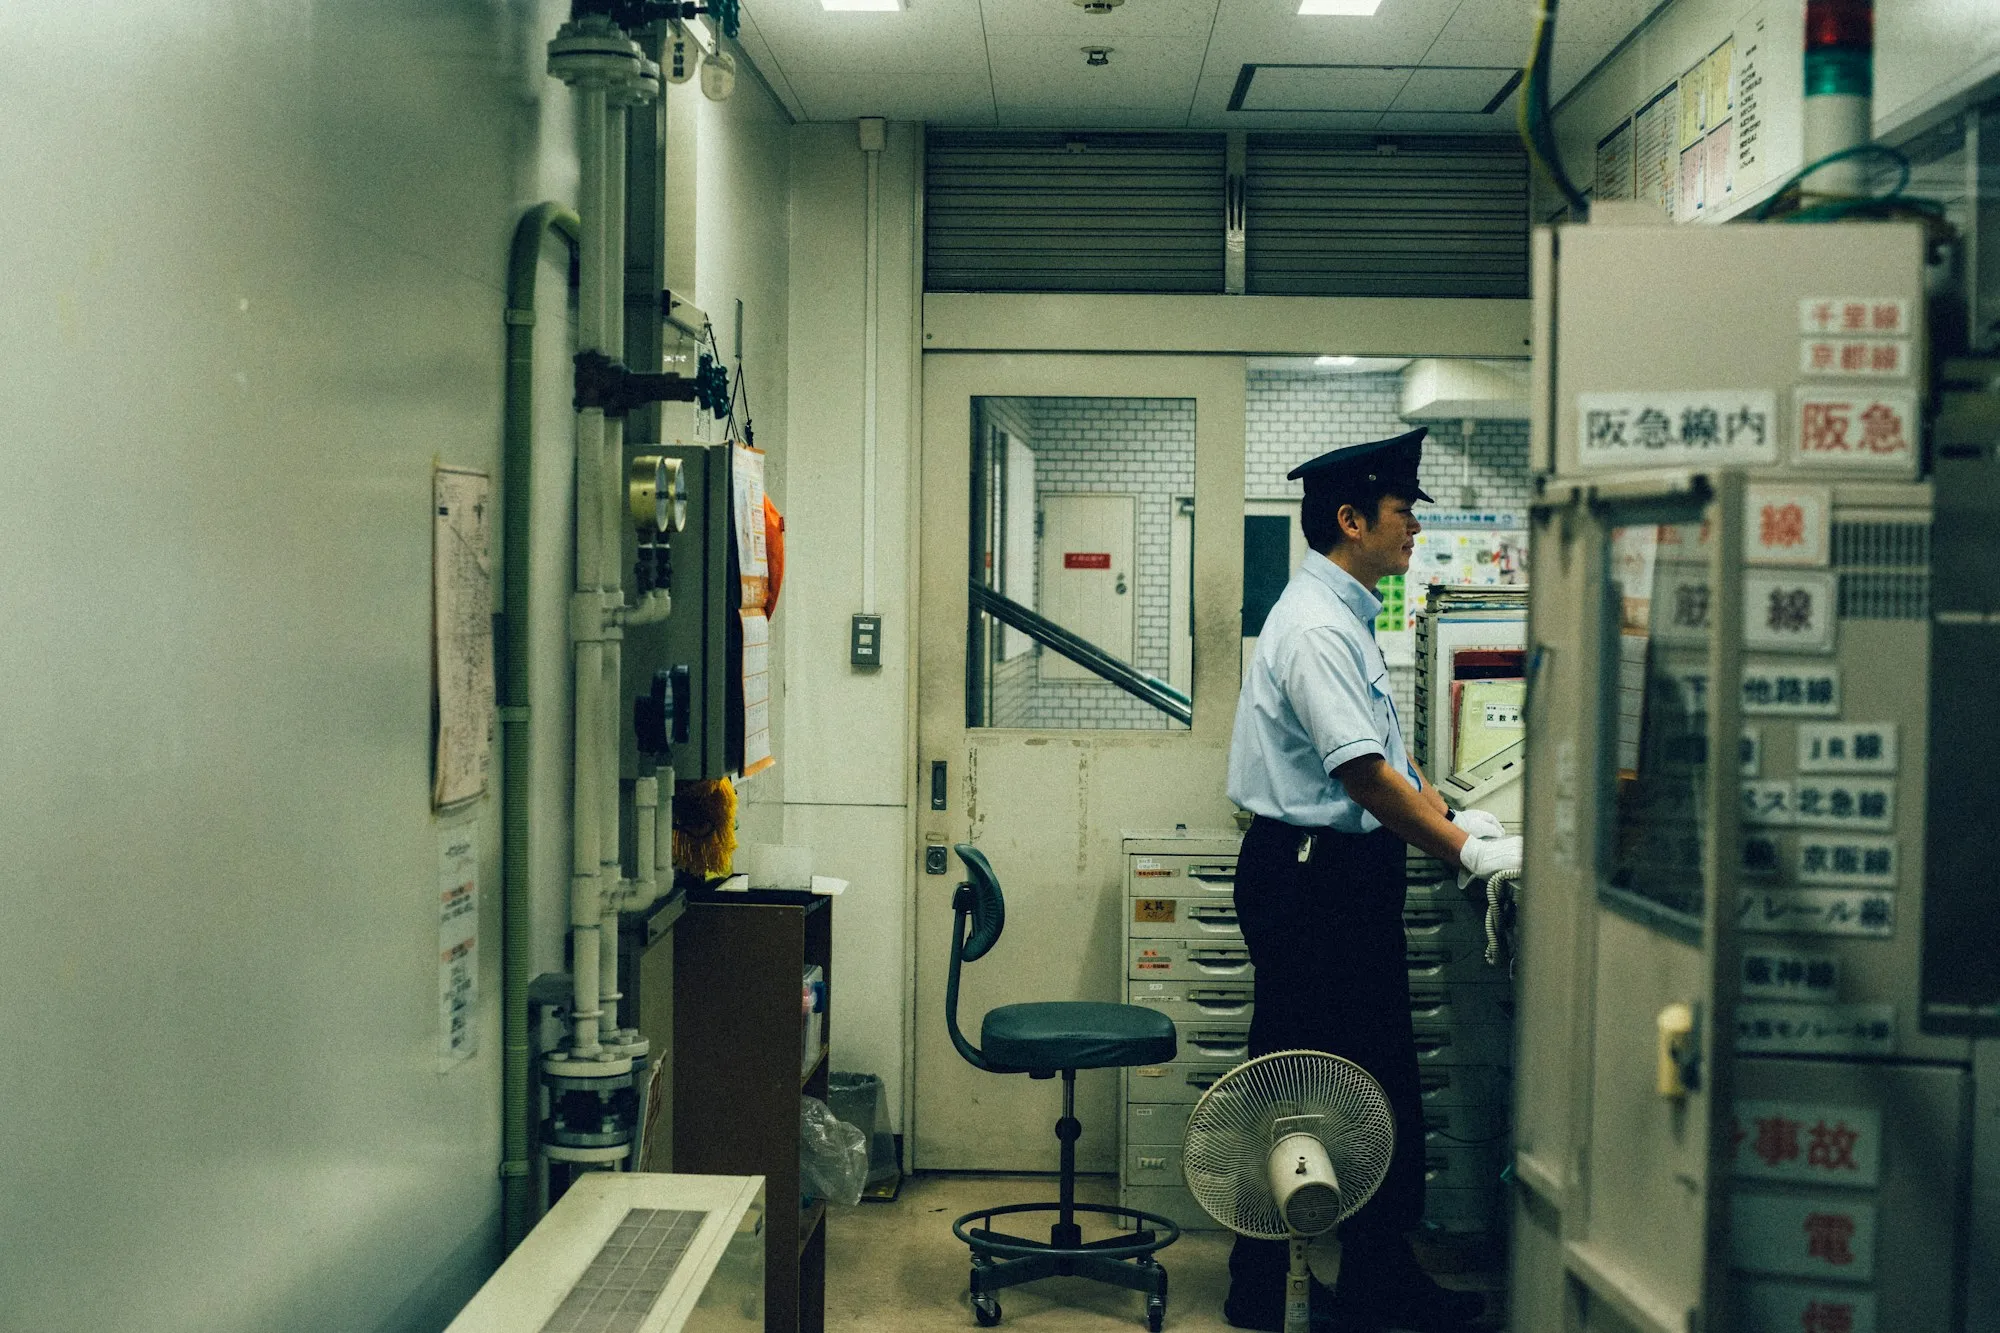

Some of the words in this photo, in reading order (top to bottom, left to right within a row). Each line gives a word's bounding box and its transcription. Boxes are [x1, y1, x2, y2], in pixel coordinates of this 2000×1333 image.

[1586, 405, 1767, 449] 阪急線内
[1802, 402, 1906, 453] 阪急
